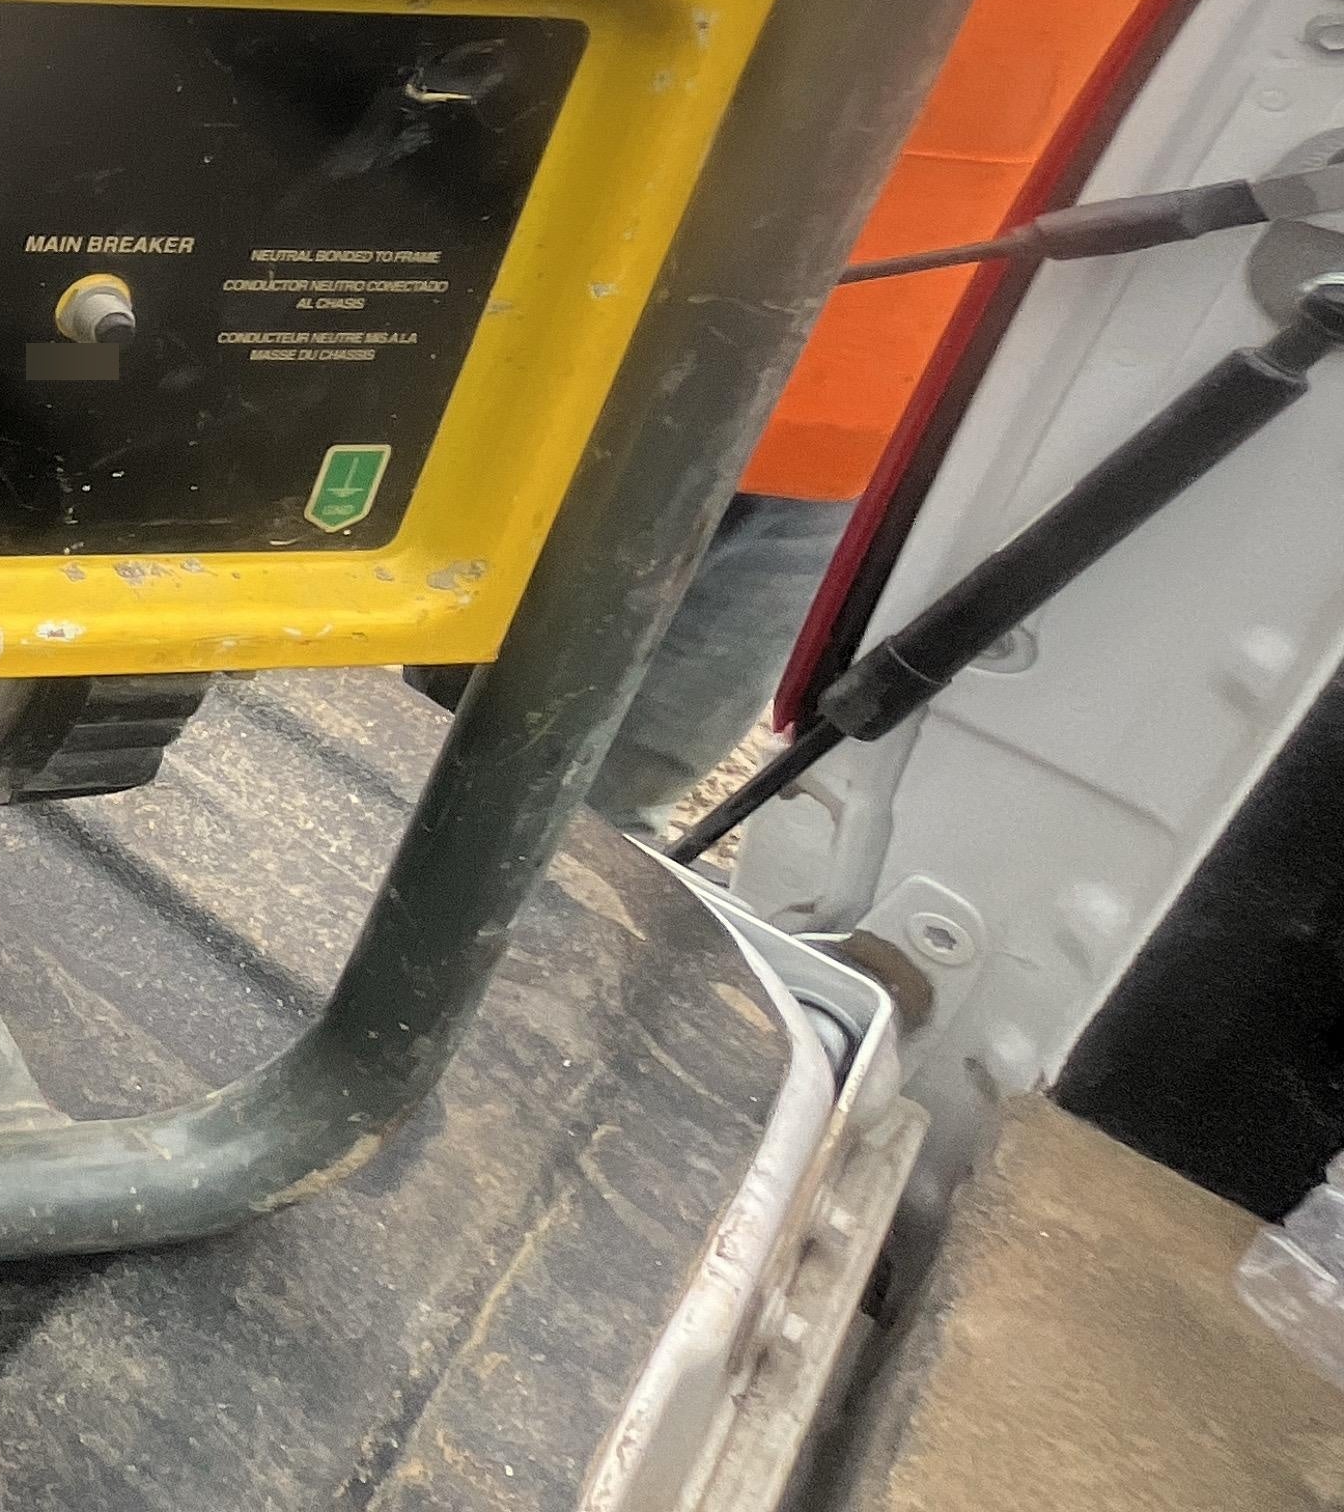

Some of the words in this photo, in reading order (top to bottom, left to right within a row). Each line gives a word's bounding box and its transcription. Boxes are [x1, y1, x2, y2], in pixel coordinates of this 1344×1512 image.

[25, 235, 83, 253] MAIN
[86, 236, 195, 254] BREAKER
[251, 249, 314, 263] NEUTRAL
[315, 250, 374, 264] BONDED
[223, 279, 310, 292] CONDUCTOR
[296, 298, 314, 310] AL
[217, 332, 311, 344] CONDUCTEUR
